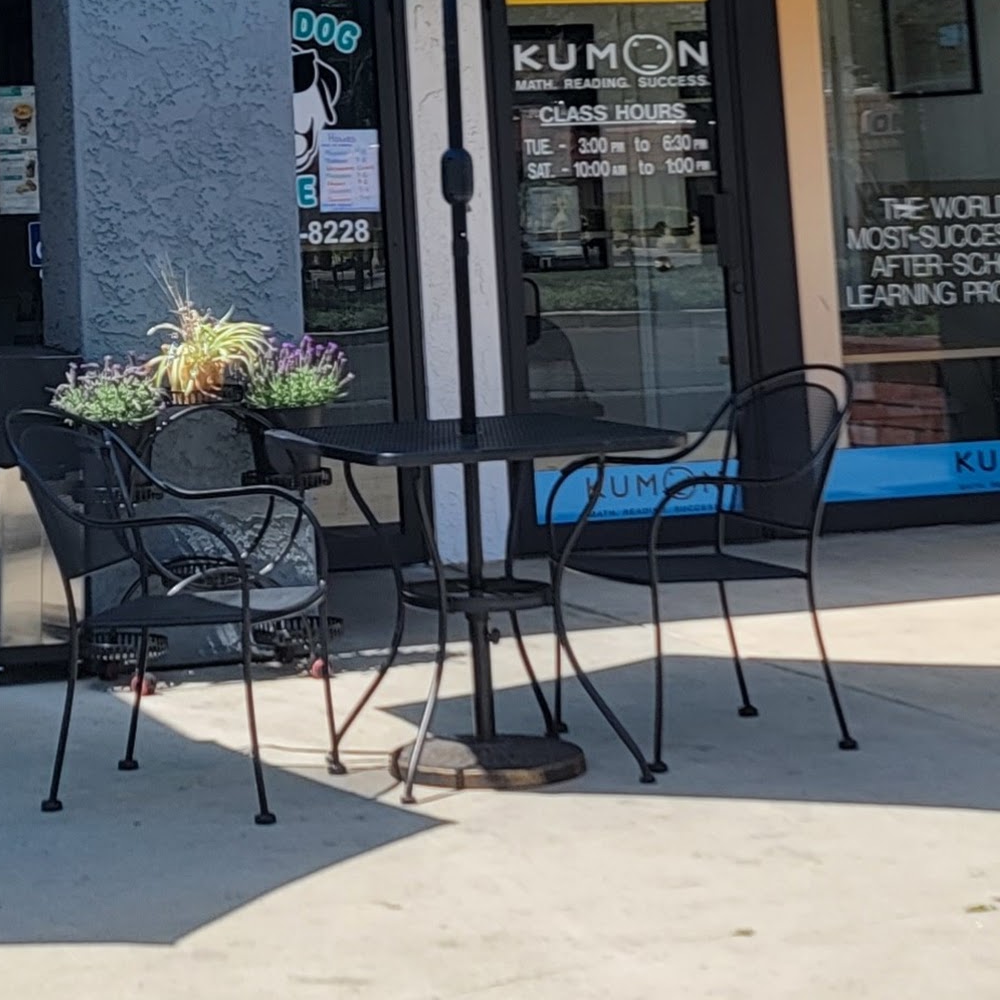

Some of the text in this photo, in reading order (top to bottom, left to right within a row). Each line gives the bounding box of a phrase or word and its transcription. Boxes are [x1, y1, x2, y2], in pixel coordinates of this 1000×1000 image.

[292, 7, 361, 53] DOG
[513, 34, 710, 76] KUMON
[539, 103, 688, 123] CLASS HOURS
[578, 137, 608, 154] 3:00
[634, 137, 650, 152] to
[662, 134, 691, 151] 6:30
[574, 161, 611, 178] 10:00
[639, 160, 655, 175] to
[665, 157, 694, 174] 1:00
[878, 196, 927, 220] THE
[846, 281, 958, 309] LEARNING
[955, 449, 997, 473] KU
